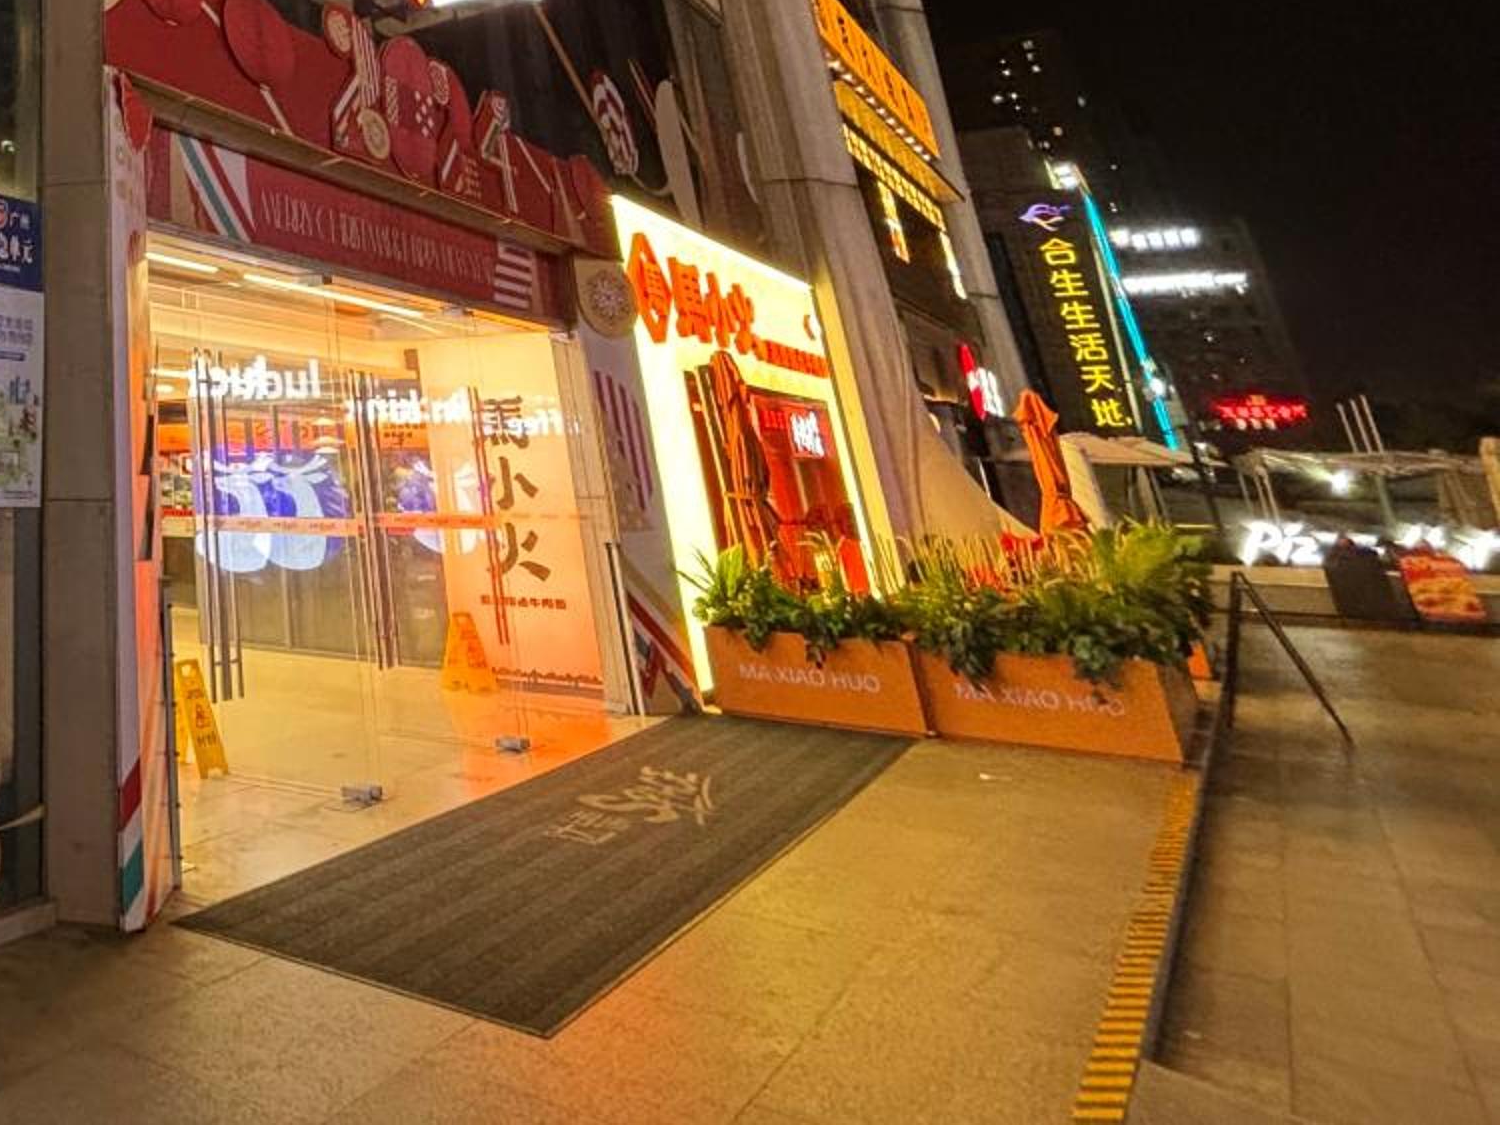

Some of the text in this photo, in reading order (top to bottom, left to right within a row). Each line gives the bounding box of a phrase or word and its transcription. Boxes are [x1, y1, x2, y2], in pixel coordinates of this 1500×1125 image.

[1039, 237, 1133, 428] 合生生活天地
[739, 664, 881, 693] MA XIAO HUO
[1001, 687, 1060, 710] XIAO
